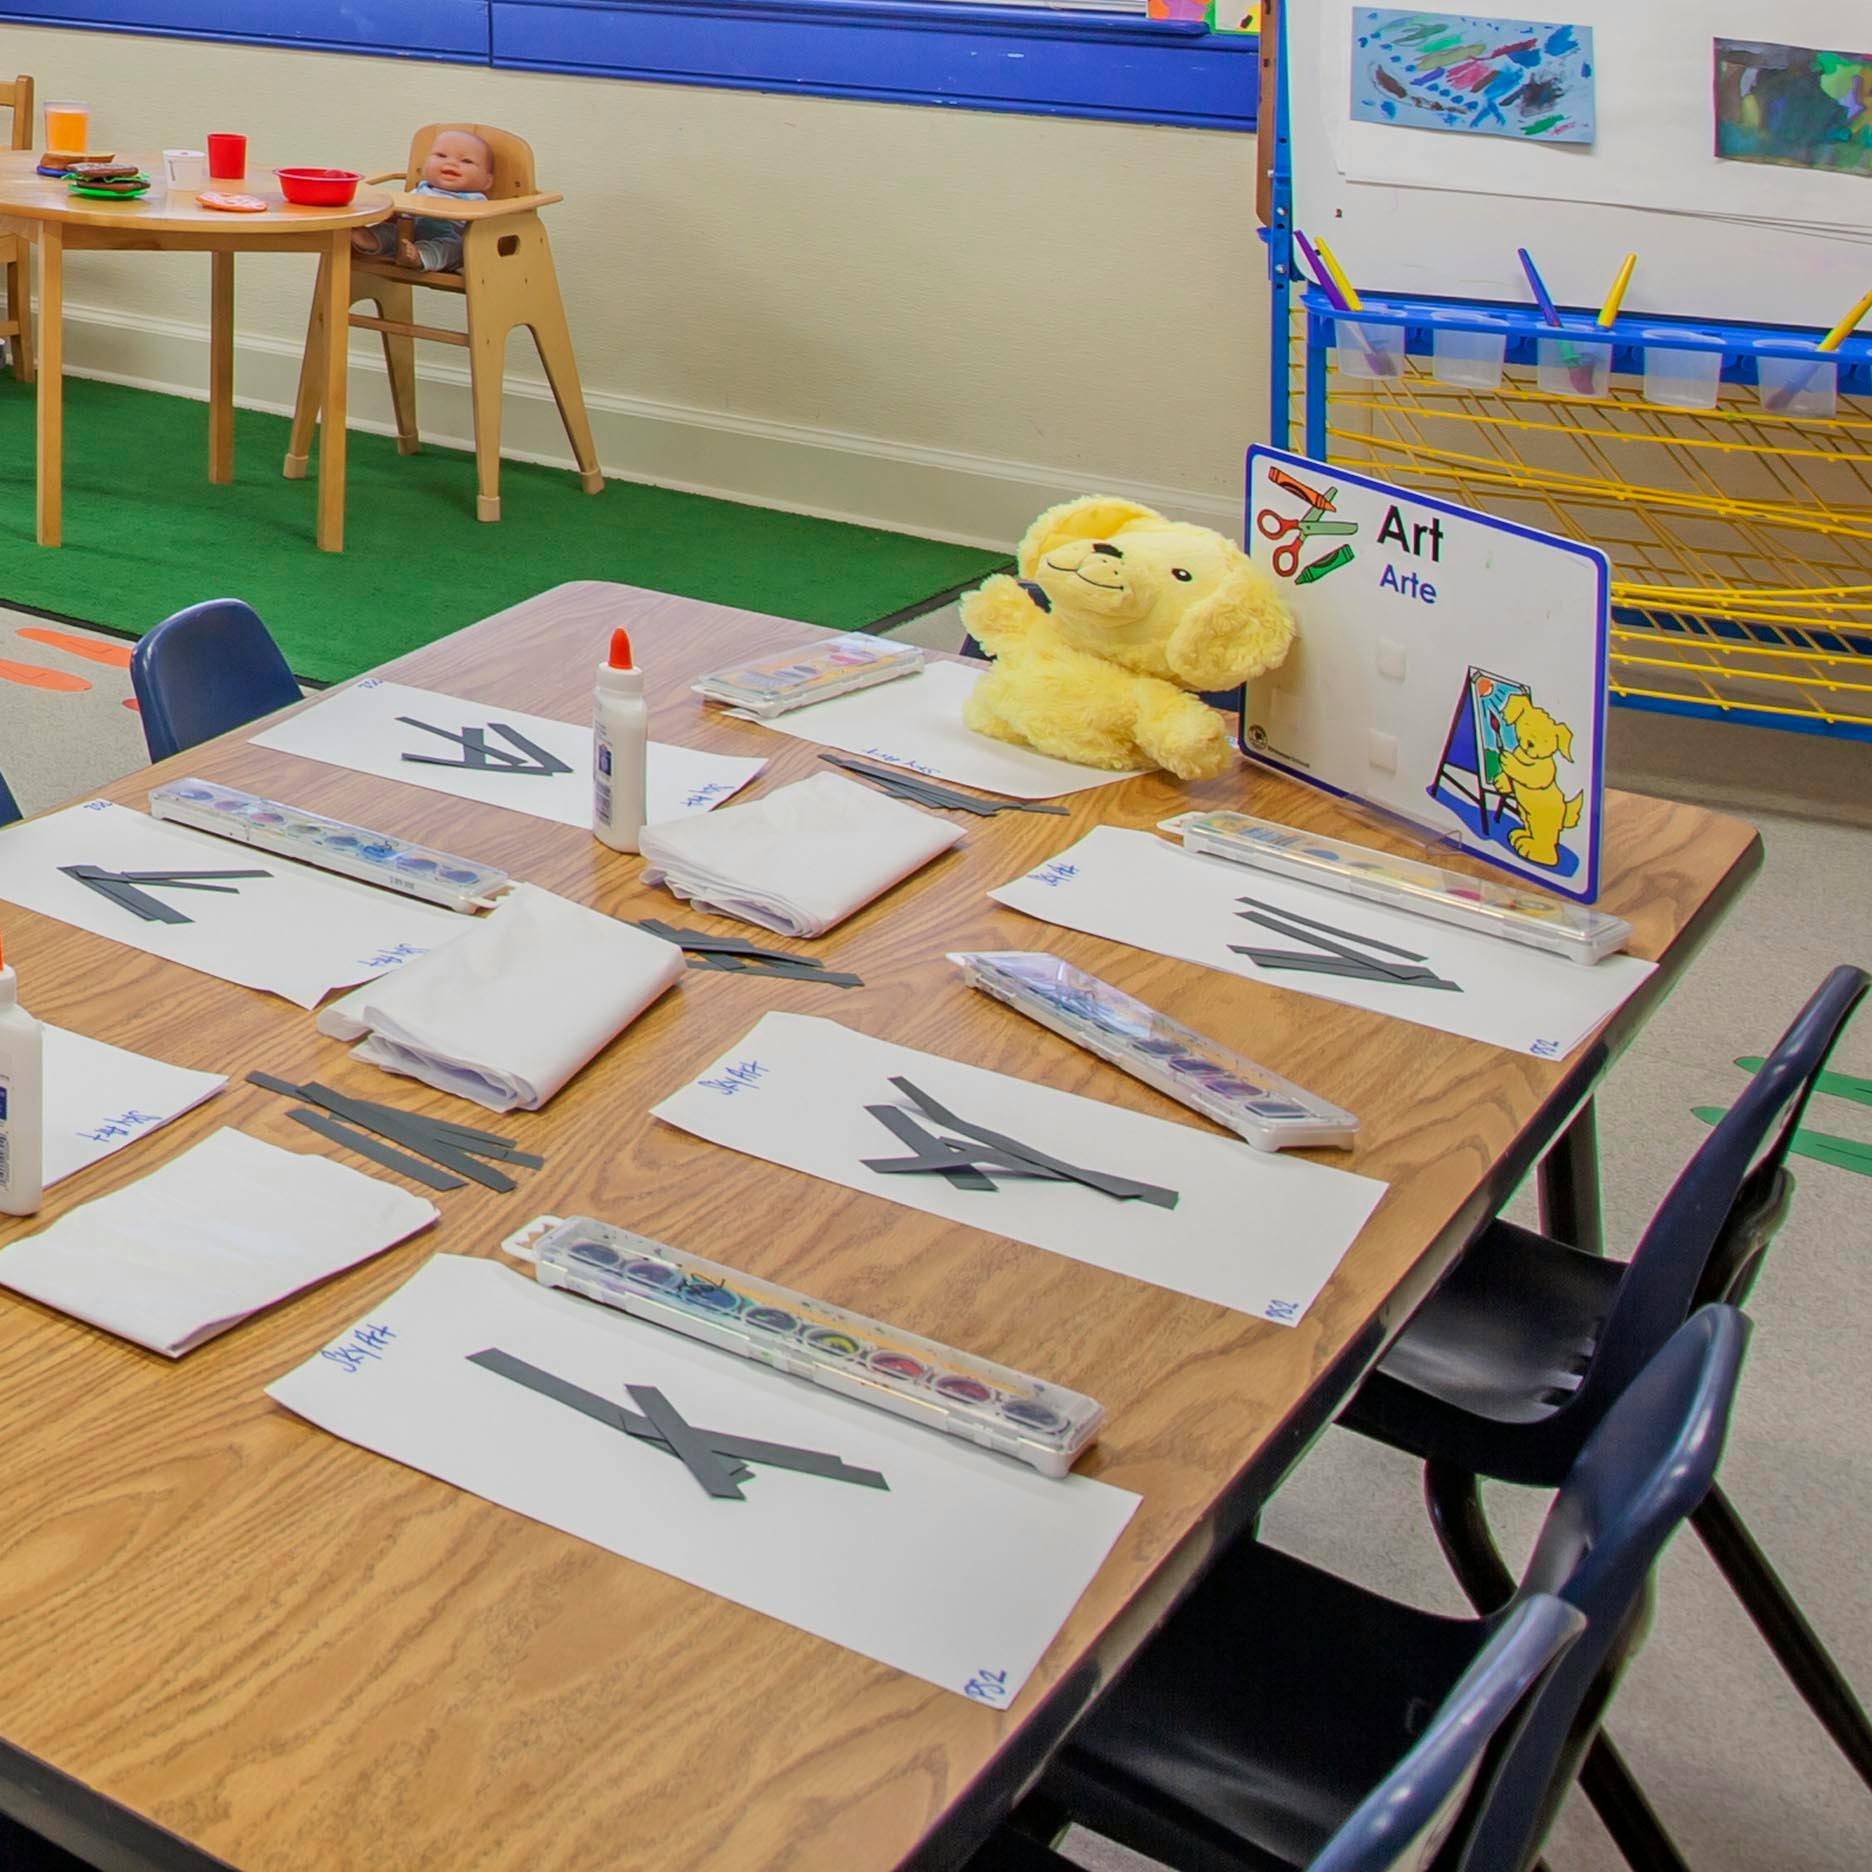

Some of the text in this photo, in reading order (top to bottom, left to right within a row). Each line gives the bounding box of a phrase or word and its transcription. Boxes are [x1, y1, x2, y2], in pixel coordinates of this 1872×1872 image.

[1377, 505, 1444, 563] Art
[1380, 563, 1438, 605] Arte
[964, 1669, 1007, 1702] PS2
